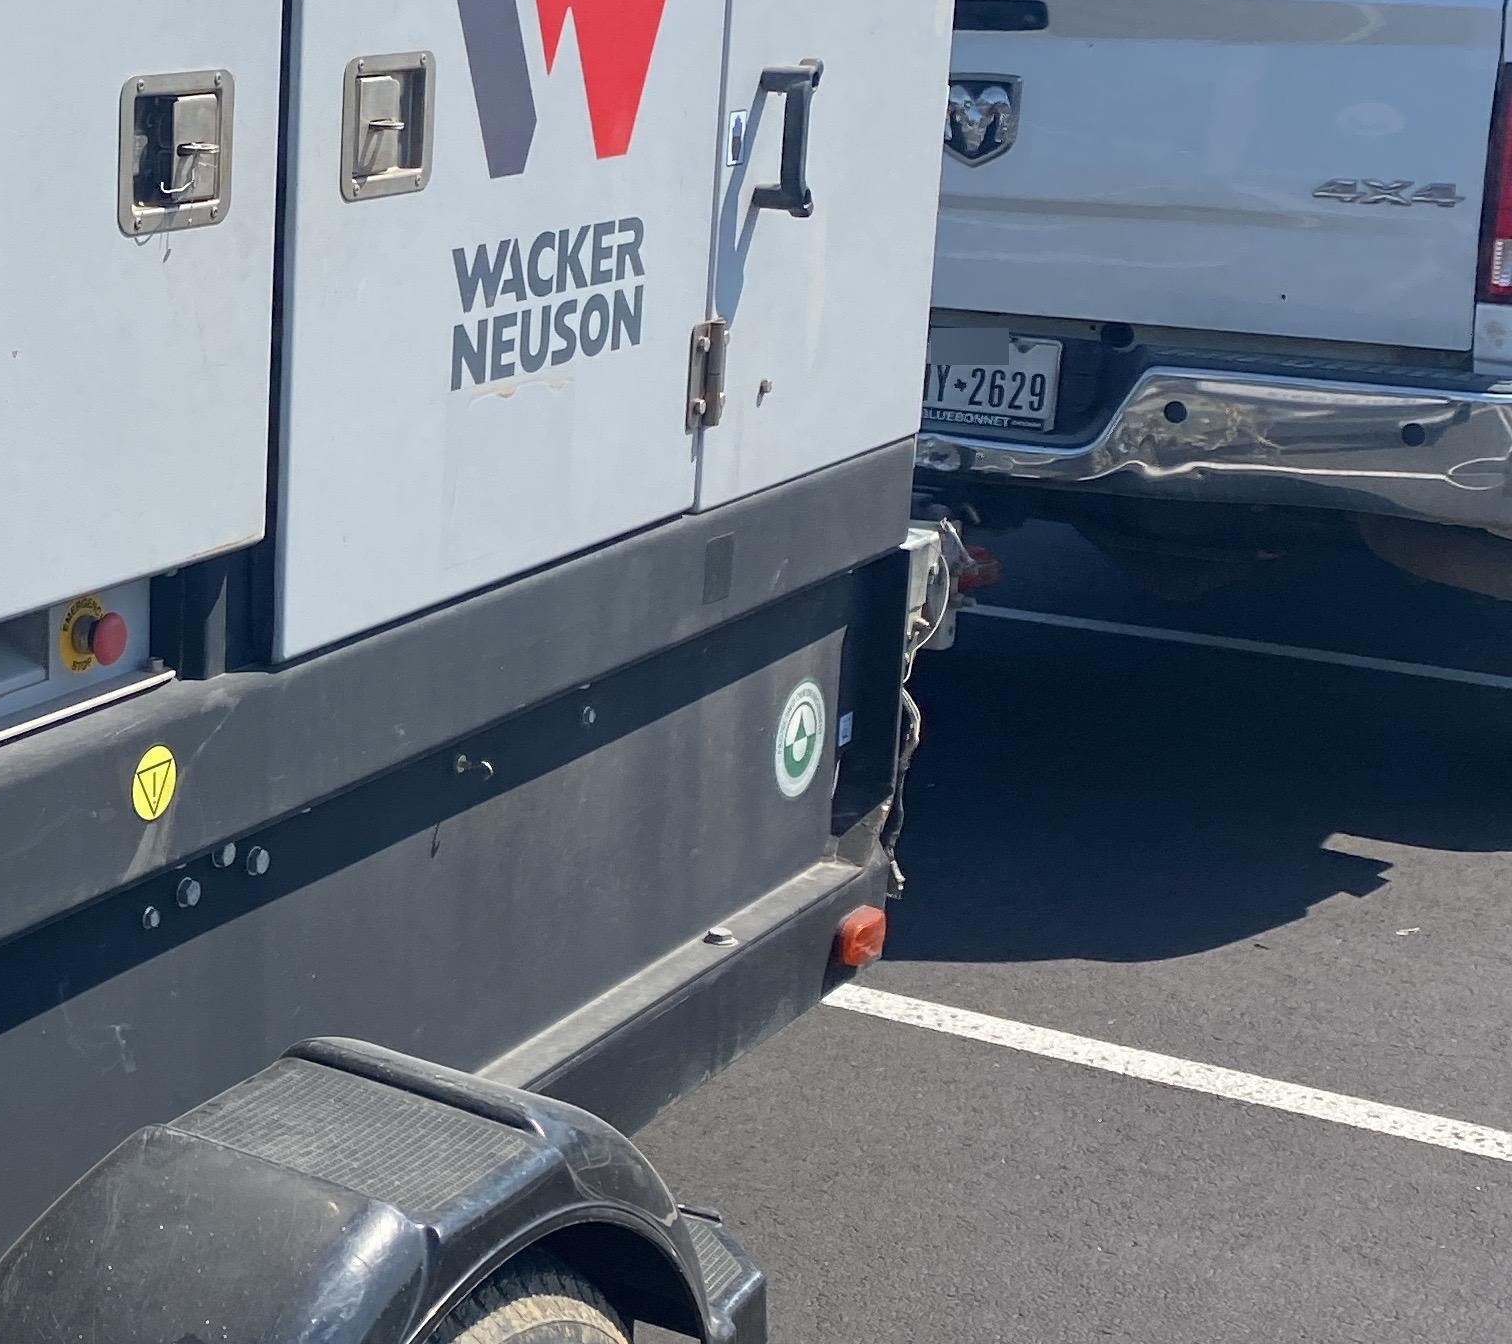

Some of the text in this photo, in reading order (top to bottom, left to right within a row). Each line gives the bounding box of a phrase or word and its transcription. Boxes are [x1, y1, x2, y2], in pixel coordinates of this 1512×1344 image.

[452, 216, 646, 313] WACKER
[450, 284, 644, 392] NEUSON
[968, 367, 1046, 412] 2629
